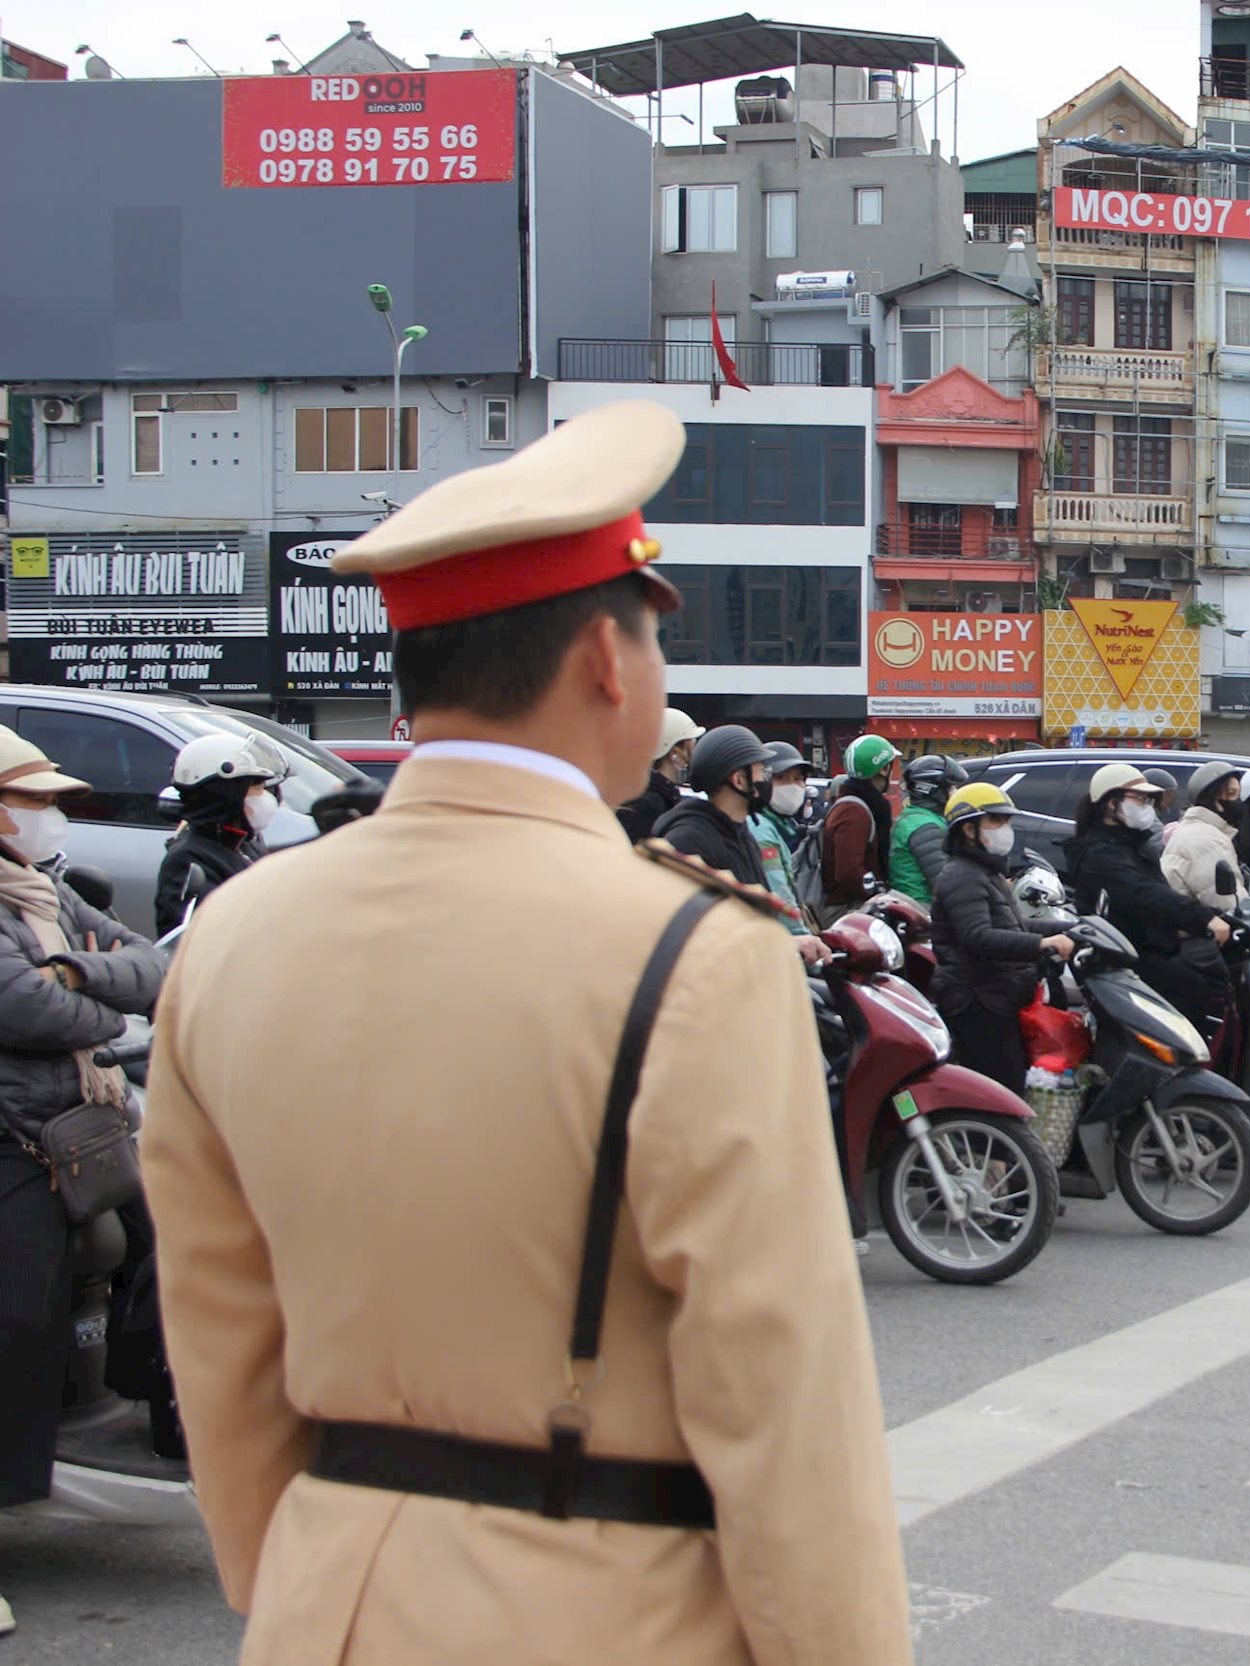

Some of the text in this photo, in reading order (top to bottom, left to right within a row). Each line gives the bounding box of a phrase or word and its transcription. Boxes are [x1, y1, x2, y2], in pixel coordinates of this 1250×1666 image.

[368, 102, 422, 113] since 2010
[260, 125, 478, 152] 0988 59 55 66
[259, 156, 477, 183] 0978 91 70 75
[1071, 188, 1165, 228] MQC:
[1173, 196, 1232, 233] 097
[55, 544, 108, 595] KÍNH
[111, 542, 142, 595] ÂU
[280, 577, 388, 643] KÍNH GỌNG
[932, 618, 1034, 642] HAPPY
[1095, 624, 1155, 637] NutriNest
[50, 642, 87, 660] KÍNH
[90, 645, 128, 662] GỌNG
[131, 642, 170, 660] HÀNG
[286, 646, 330, 673] KÍNH
[334, 647, 359, 673] ÂU
[931, 649, 1036, 672] MONEY
[66, 663, 103, 681] KÍNH
[106, 661, 128, 680] ÂU
[140, 662, 167, 680] BÙI
[872, 750, 890, 765] Grab
